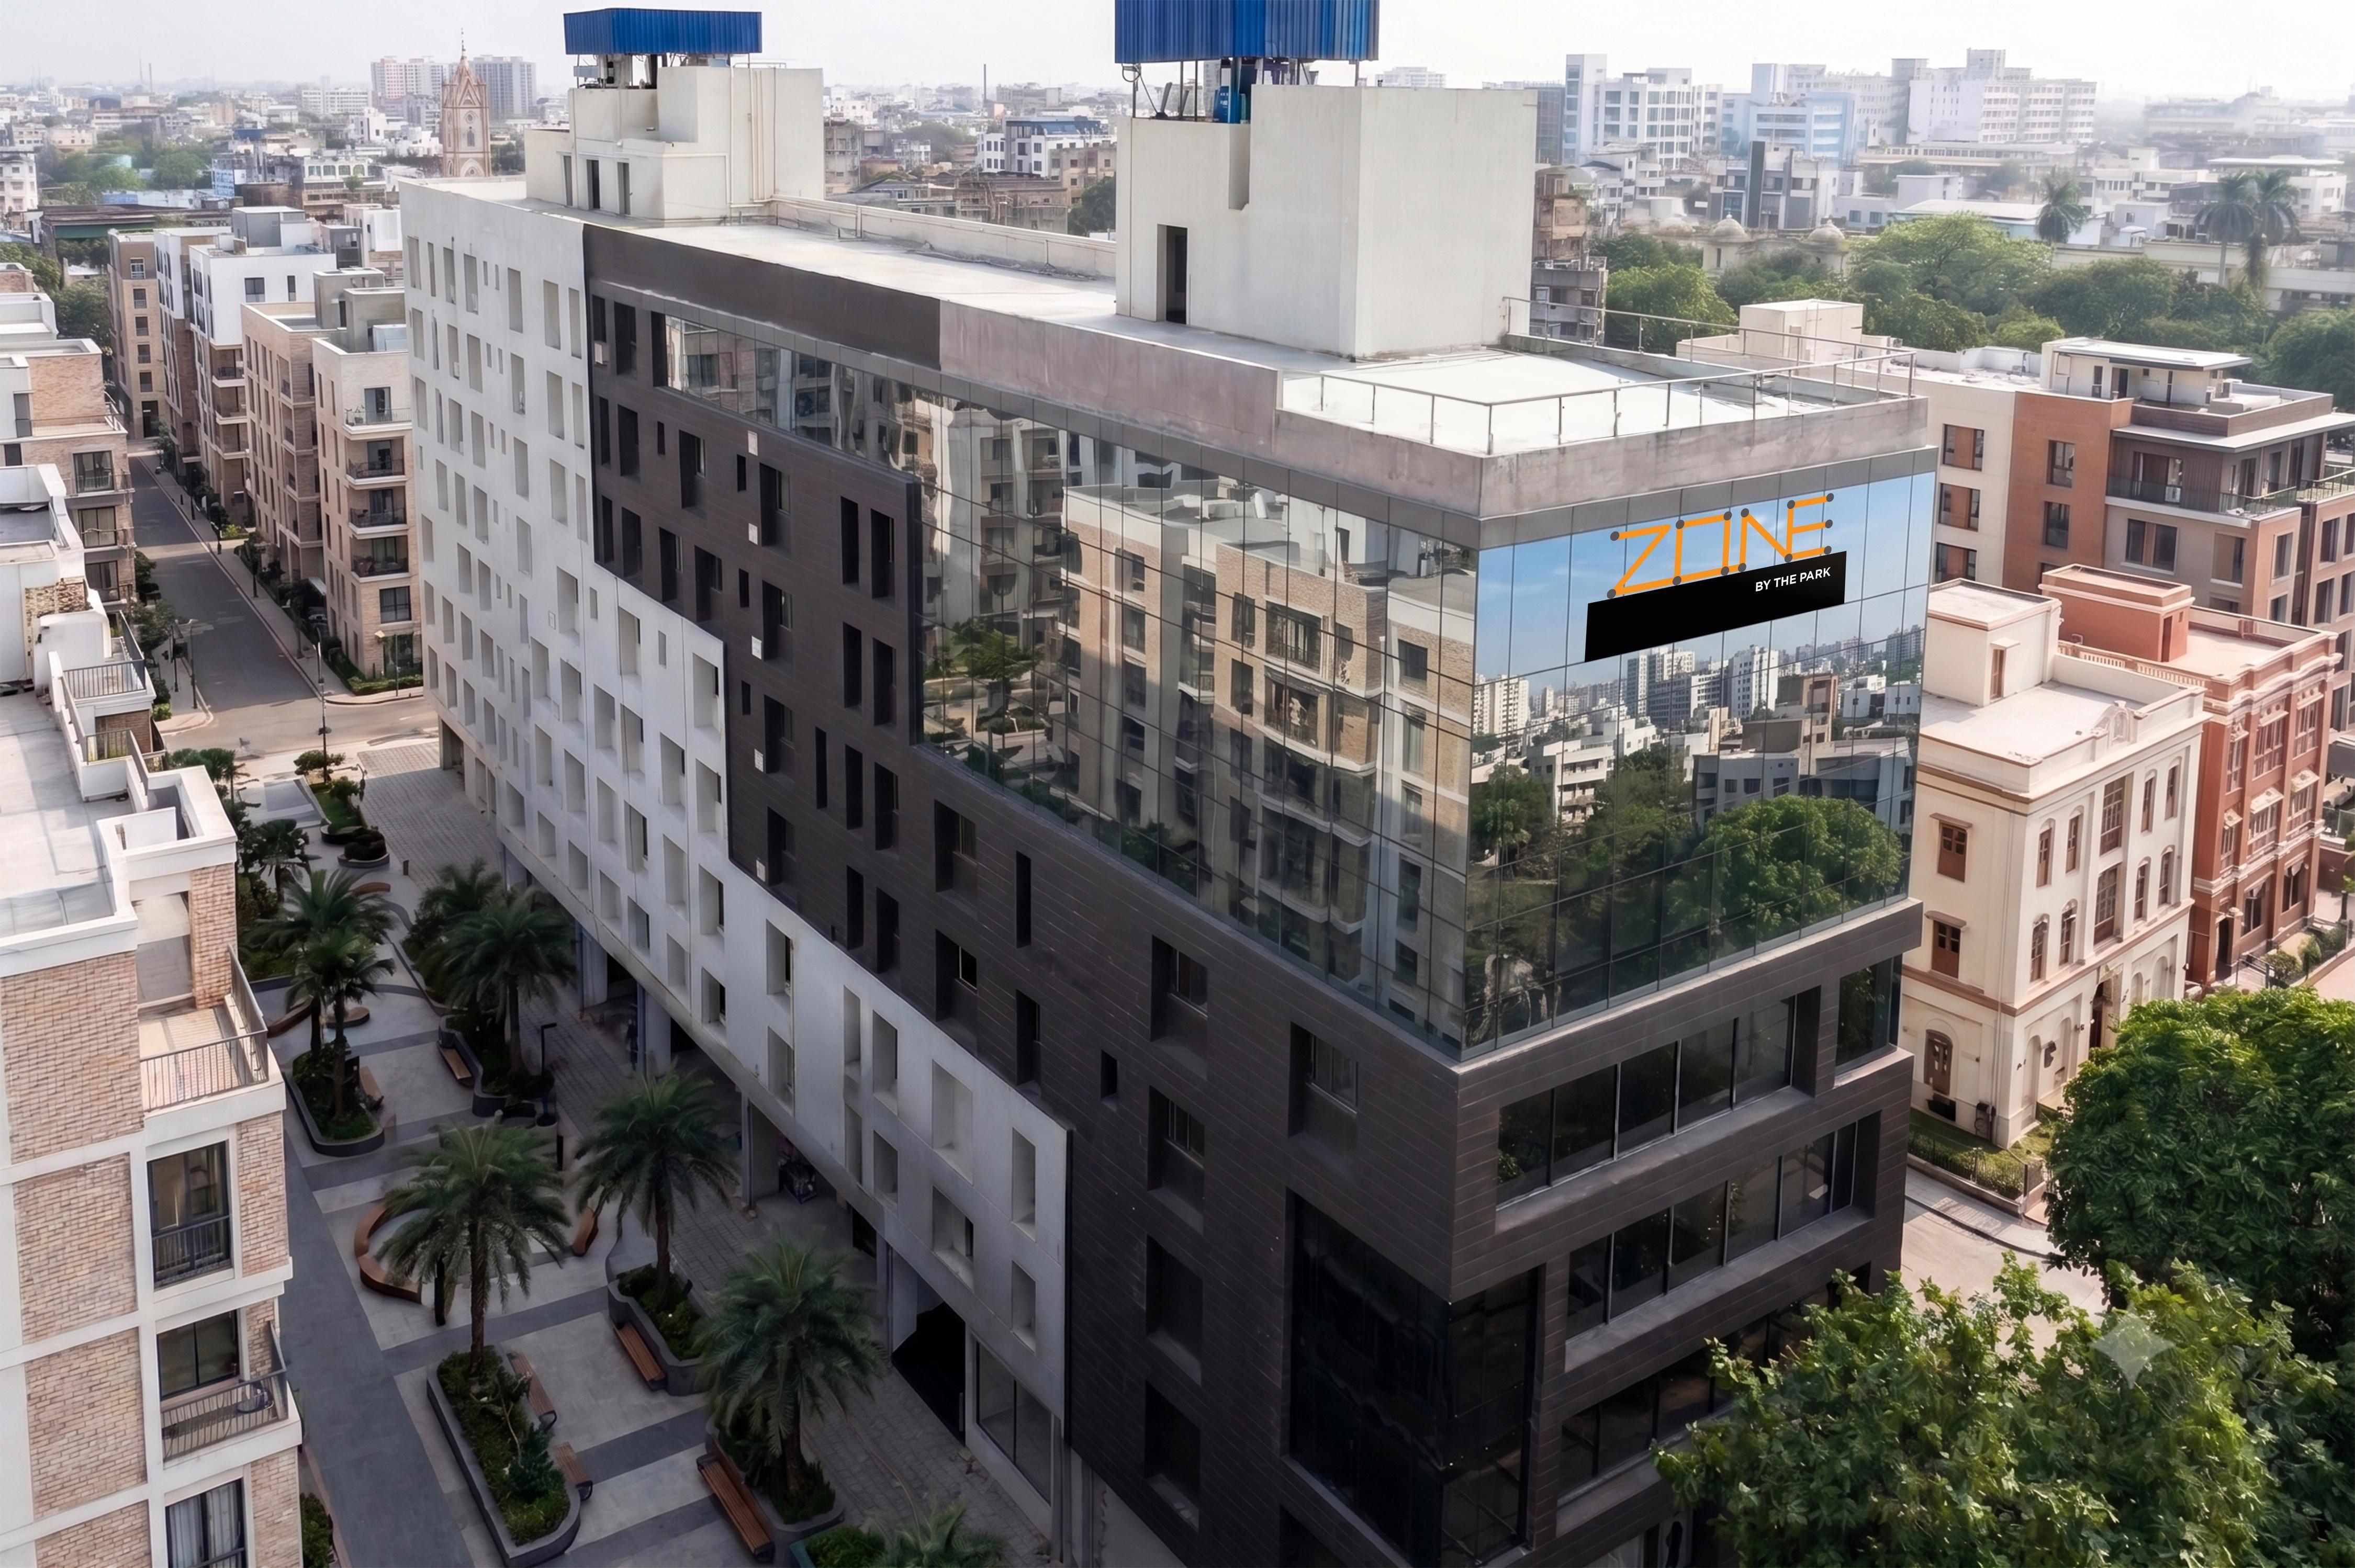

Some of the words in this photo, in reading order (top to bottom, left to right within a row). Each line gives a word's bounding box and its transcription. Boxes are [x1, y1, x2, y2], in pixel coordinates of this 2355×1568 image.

[1607, 493, 1834, 599] ZONE
[1755, 579, 1771, 592] BY
[1774, 574, 1797, 588] THE
[1800, 567, 1831, 582] PARK
